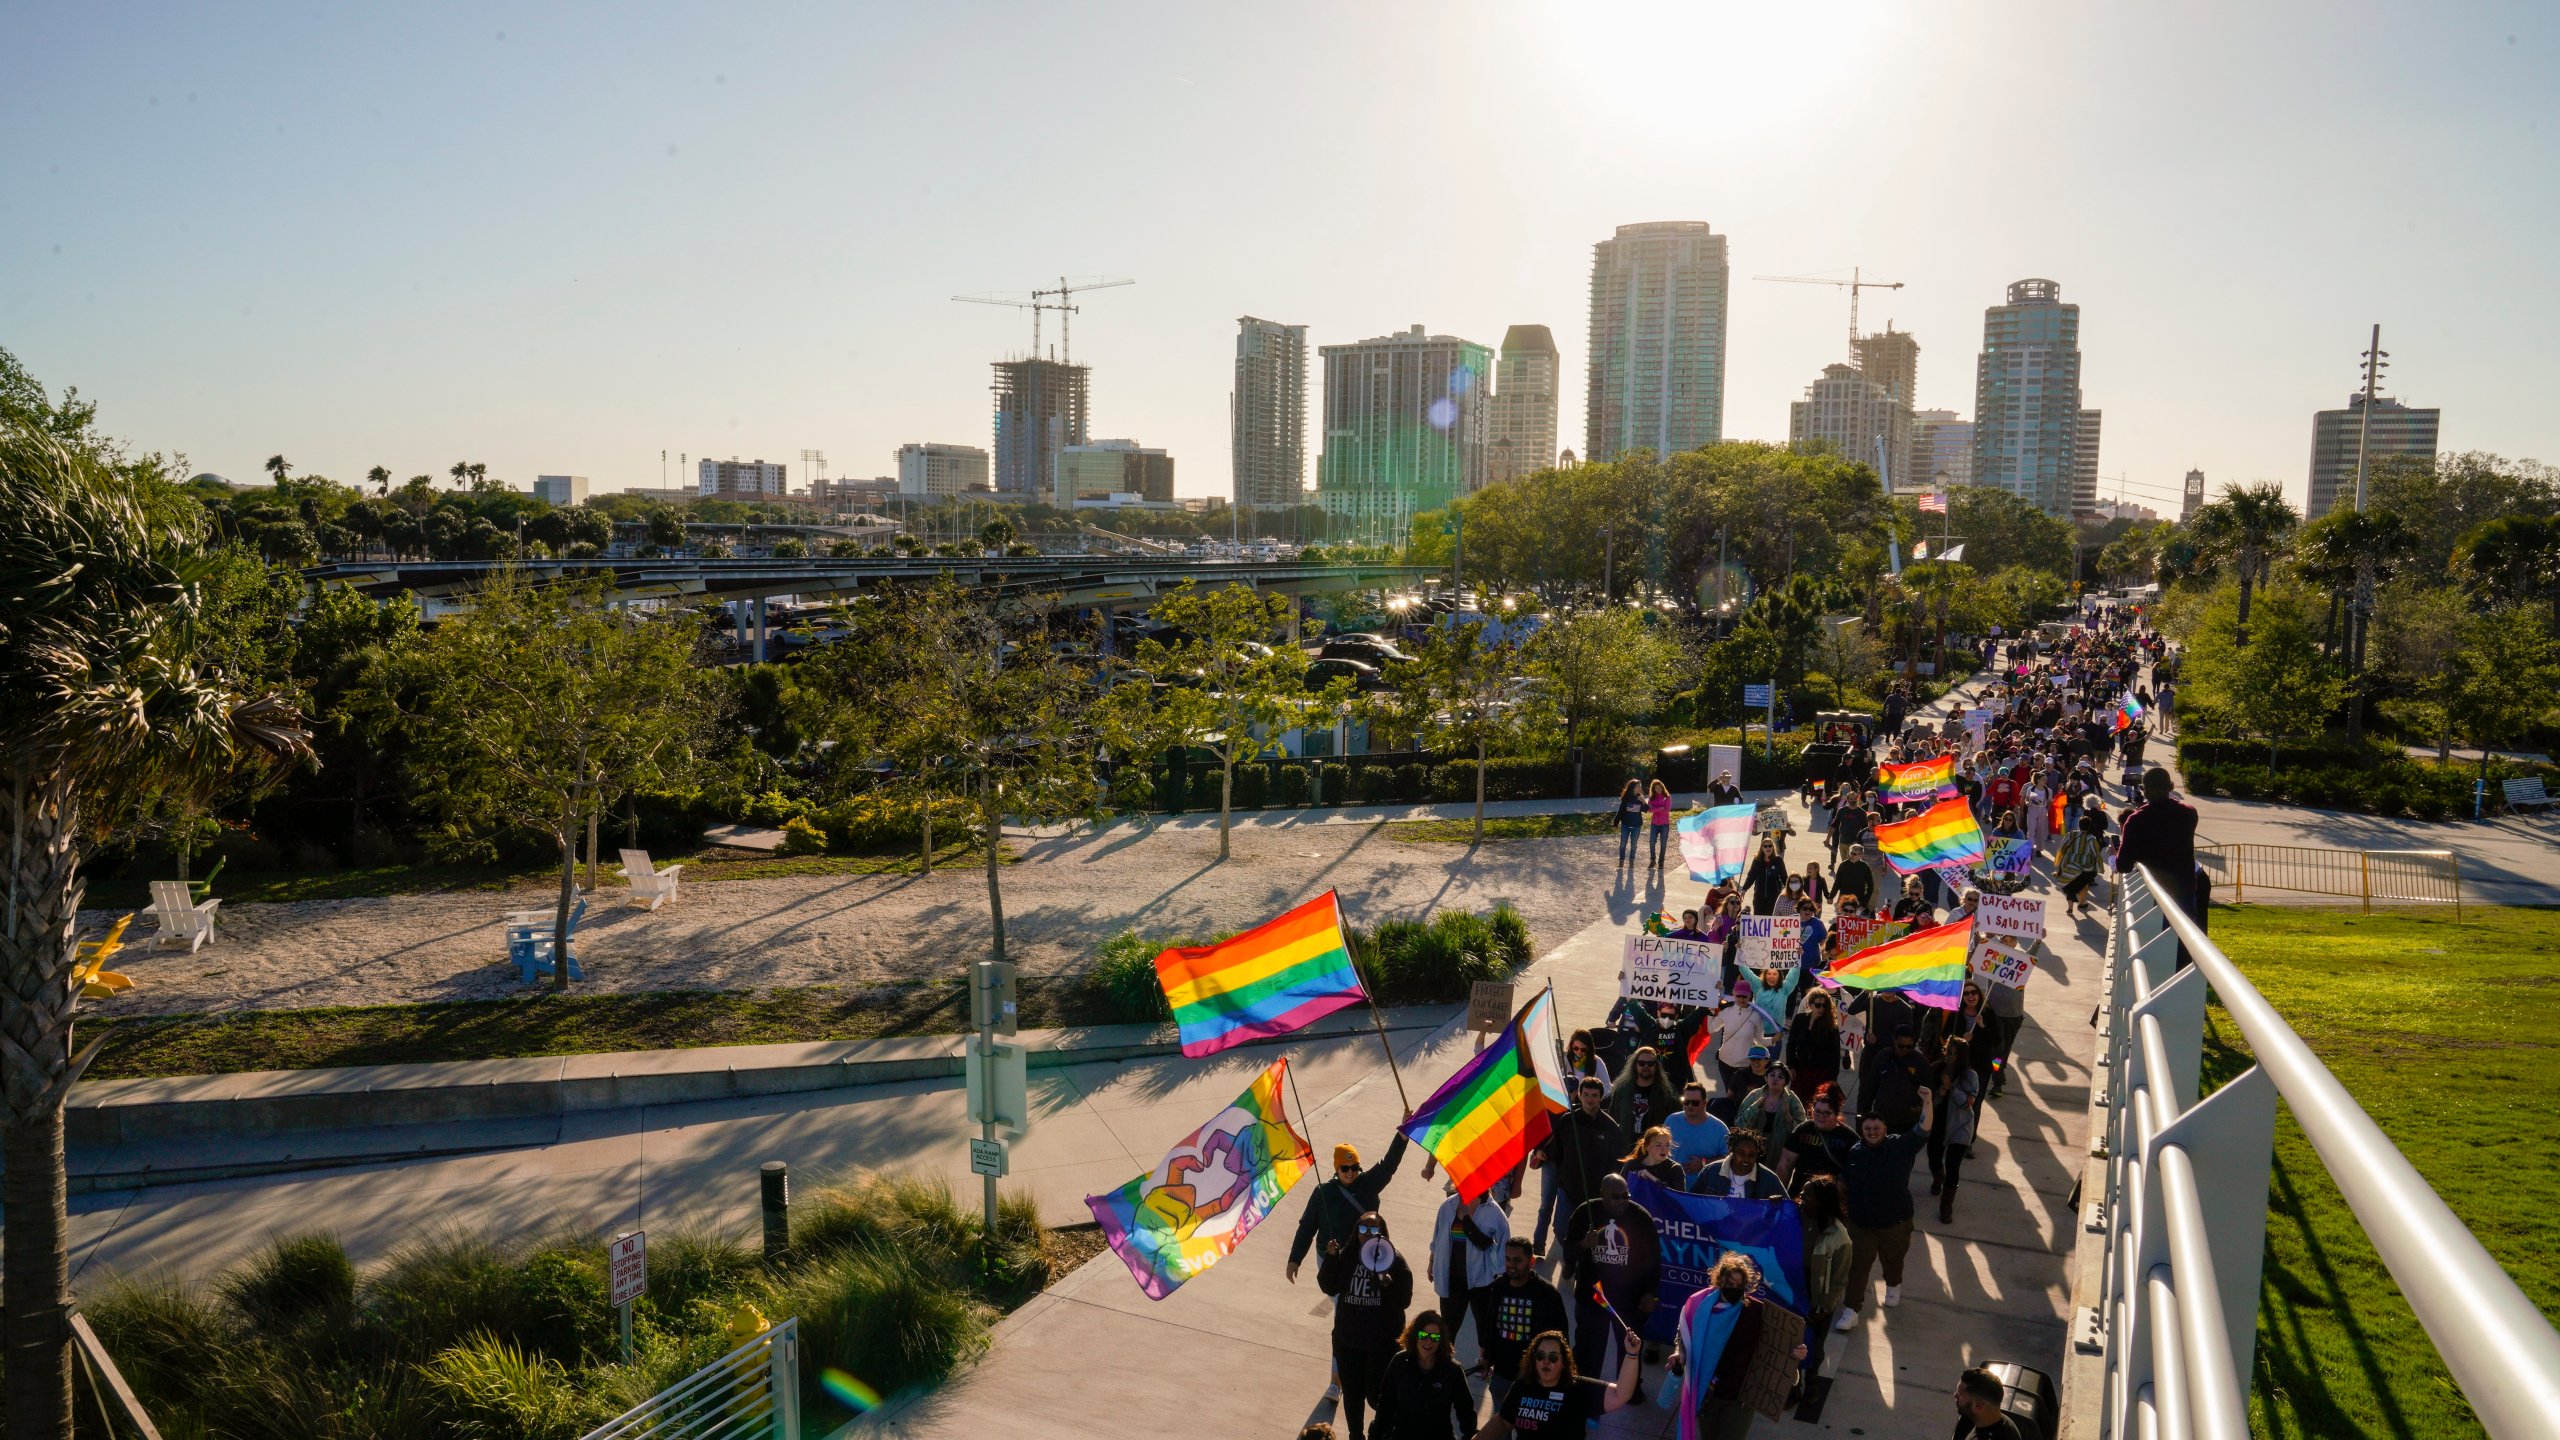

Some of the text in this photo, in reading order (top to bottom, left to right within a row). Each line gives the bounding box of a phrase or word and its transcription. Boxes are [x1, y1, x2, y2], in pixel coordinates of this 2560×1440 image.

[1905, 772, 1922, 780] LIVE
[1993, 855, 2027, 872] GAY
[1981, 895, 2042, 913] GAY GAY GAY
[1741, 918, 1772, 937] TEACH
[1773, 918, 1800, 928] LGBTQ
[1986, 915, 2040, 934] I SAID IT!
[1772, 938, 1802, 950] RIGHTS
[1837, 929, 1865, 945] TEACH
[1633, 938, 1711, 960] HEATHER
[1770, 950, 1801, 960] PROTECT
[1634, 954, 1696, 976] already
[1770, 960, 1799, 969] OUR KIDS
[1984, 948, 2028, 972] PROUD TO
[1633, 970, 1691, 986] has 2
[1980, 959, 2023, 983] SAY GAY
[1630, 984, 1708, 1001] MOMMIES
[975, 1154, 997, 1163] ACCESS
[622, 1239, 634, 1256] NO
[1659, 1236, 1717, 1269] AYN
[613, 1249, 644, 1271] STOPPING/
[616, 1261, 642, 1279] PARKING
[615, 1269, 643, 1290] ANY TIME
[614, 1281, 644, 1302] FIRE LANE
[1519, 1396, 1563, 1413] PROTECT
[1517, 1407, 1550, 1422] TRANS
[1514, 1417, 1539, 1431] KIDS
